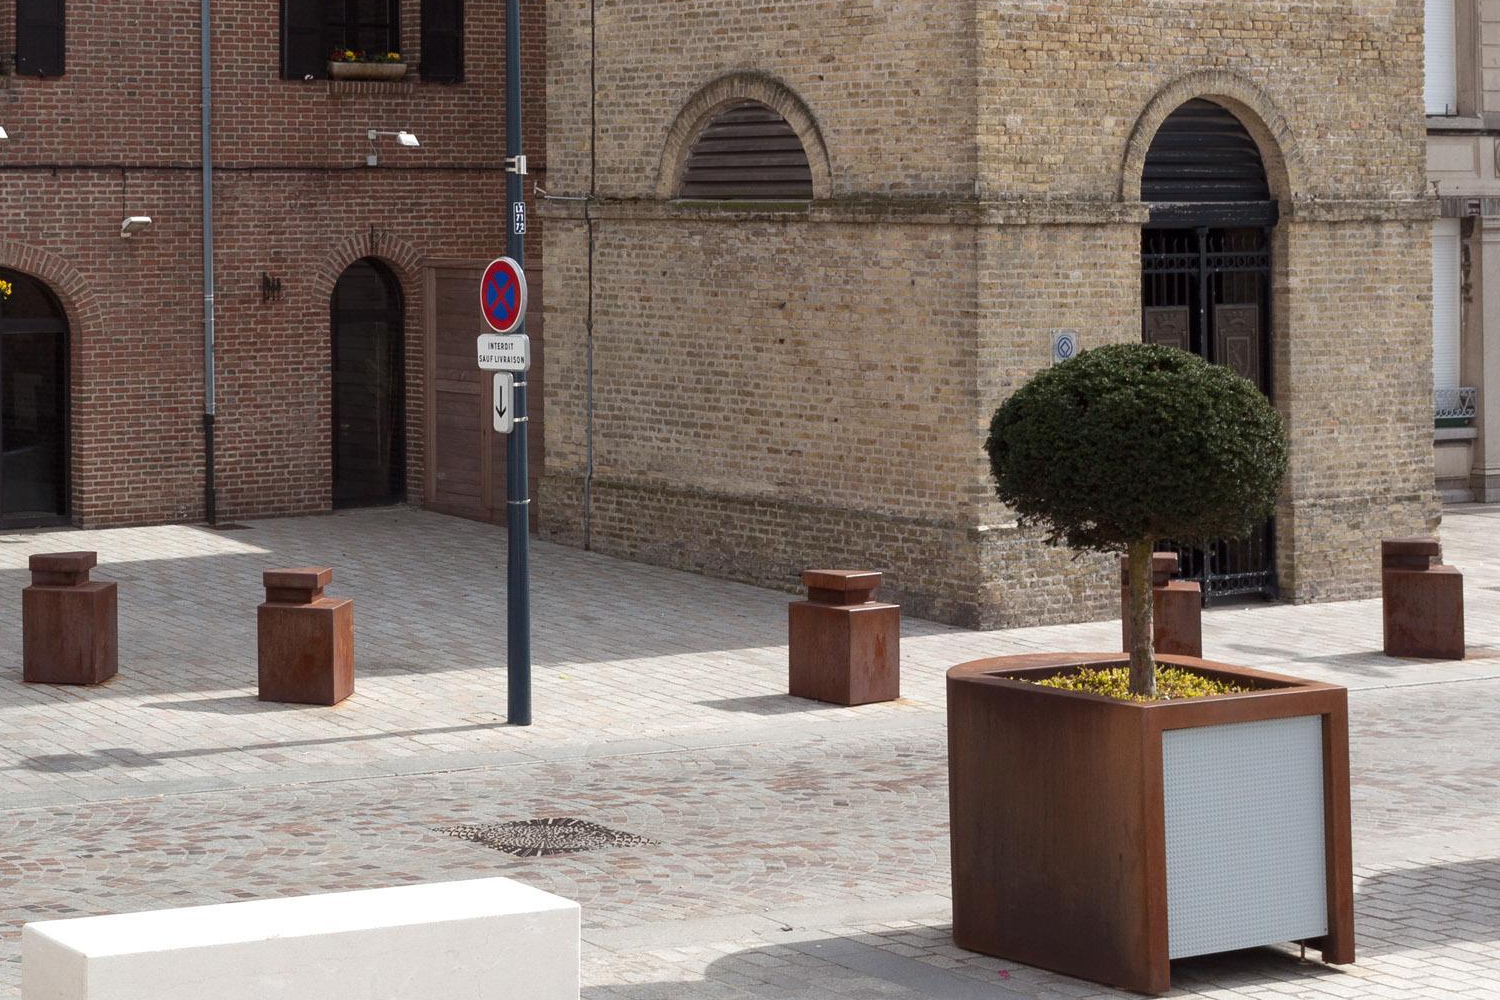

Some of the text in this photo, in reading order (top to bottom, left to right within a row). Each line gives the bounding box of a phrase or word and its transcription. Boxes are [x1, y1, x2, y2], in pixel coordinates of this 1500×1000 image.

[516, 213, 524, 221] 71
[516, 222, 524, 230] 72
[487, 342, 514, 350] INTERDIT
[479, 355, 525, 364] SAUF LIVRAISON
